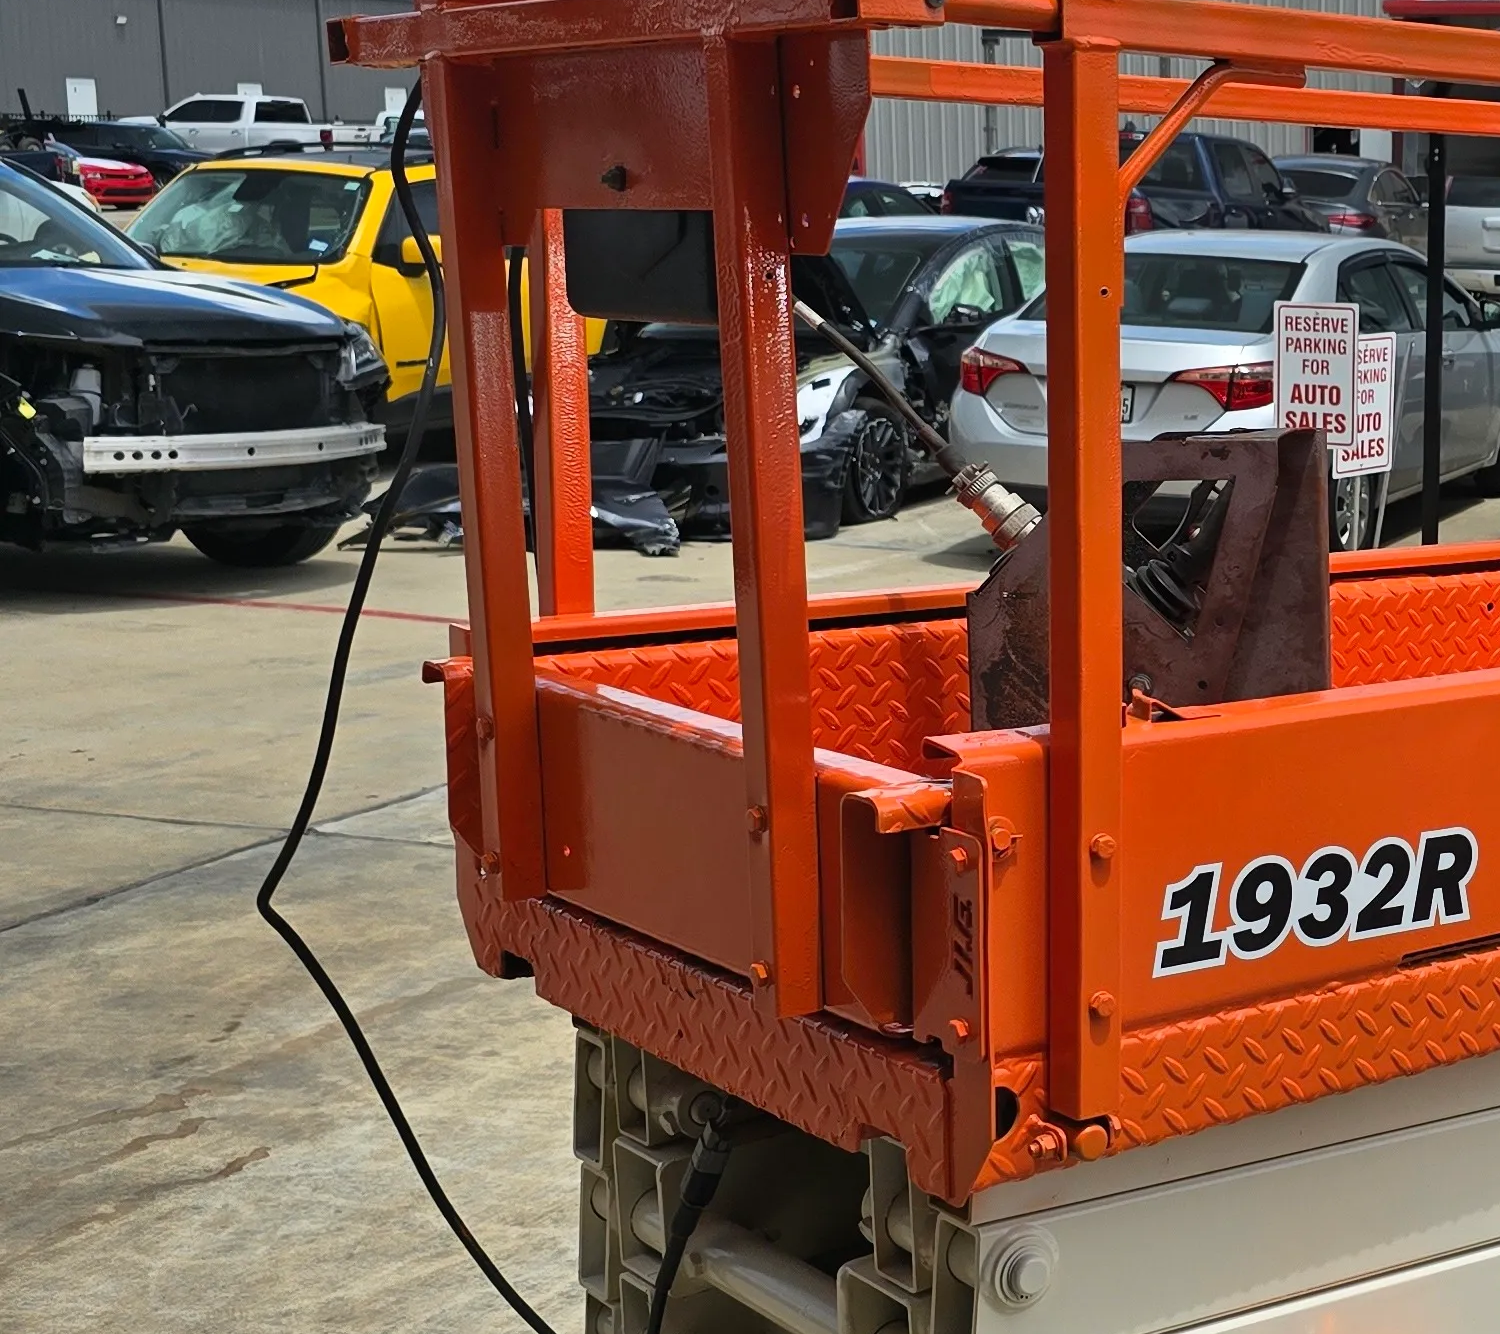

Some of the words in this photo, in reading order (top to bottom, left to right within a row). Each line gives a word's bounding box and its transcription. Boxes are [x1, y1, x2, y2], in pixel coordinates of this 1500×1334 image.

[1285, 315, 1349, 334] RESERVE
[1285, 337, 1347, 355] PARKING
[1358, 347, 1389, 366] SERVE
[1302, 359, 1330, 376] FOR
[1358, 367, 1387, 384] RKING
[1290, 383, 1341, 406] AUTO
[1285, 411, 1347, 434] SALES
[1357, 412, 1382, 433] UTO
[1341, 437, 1385, 462] SALES
[1153, 827, 1478, 978] 1932R
[953, 894, 973, 996] JLG
